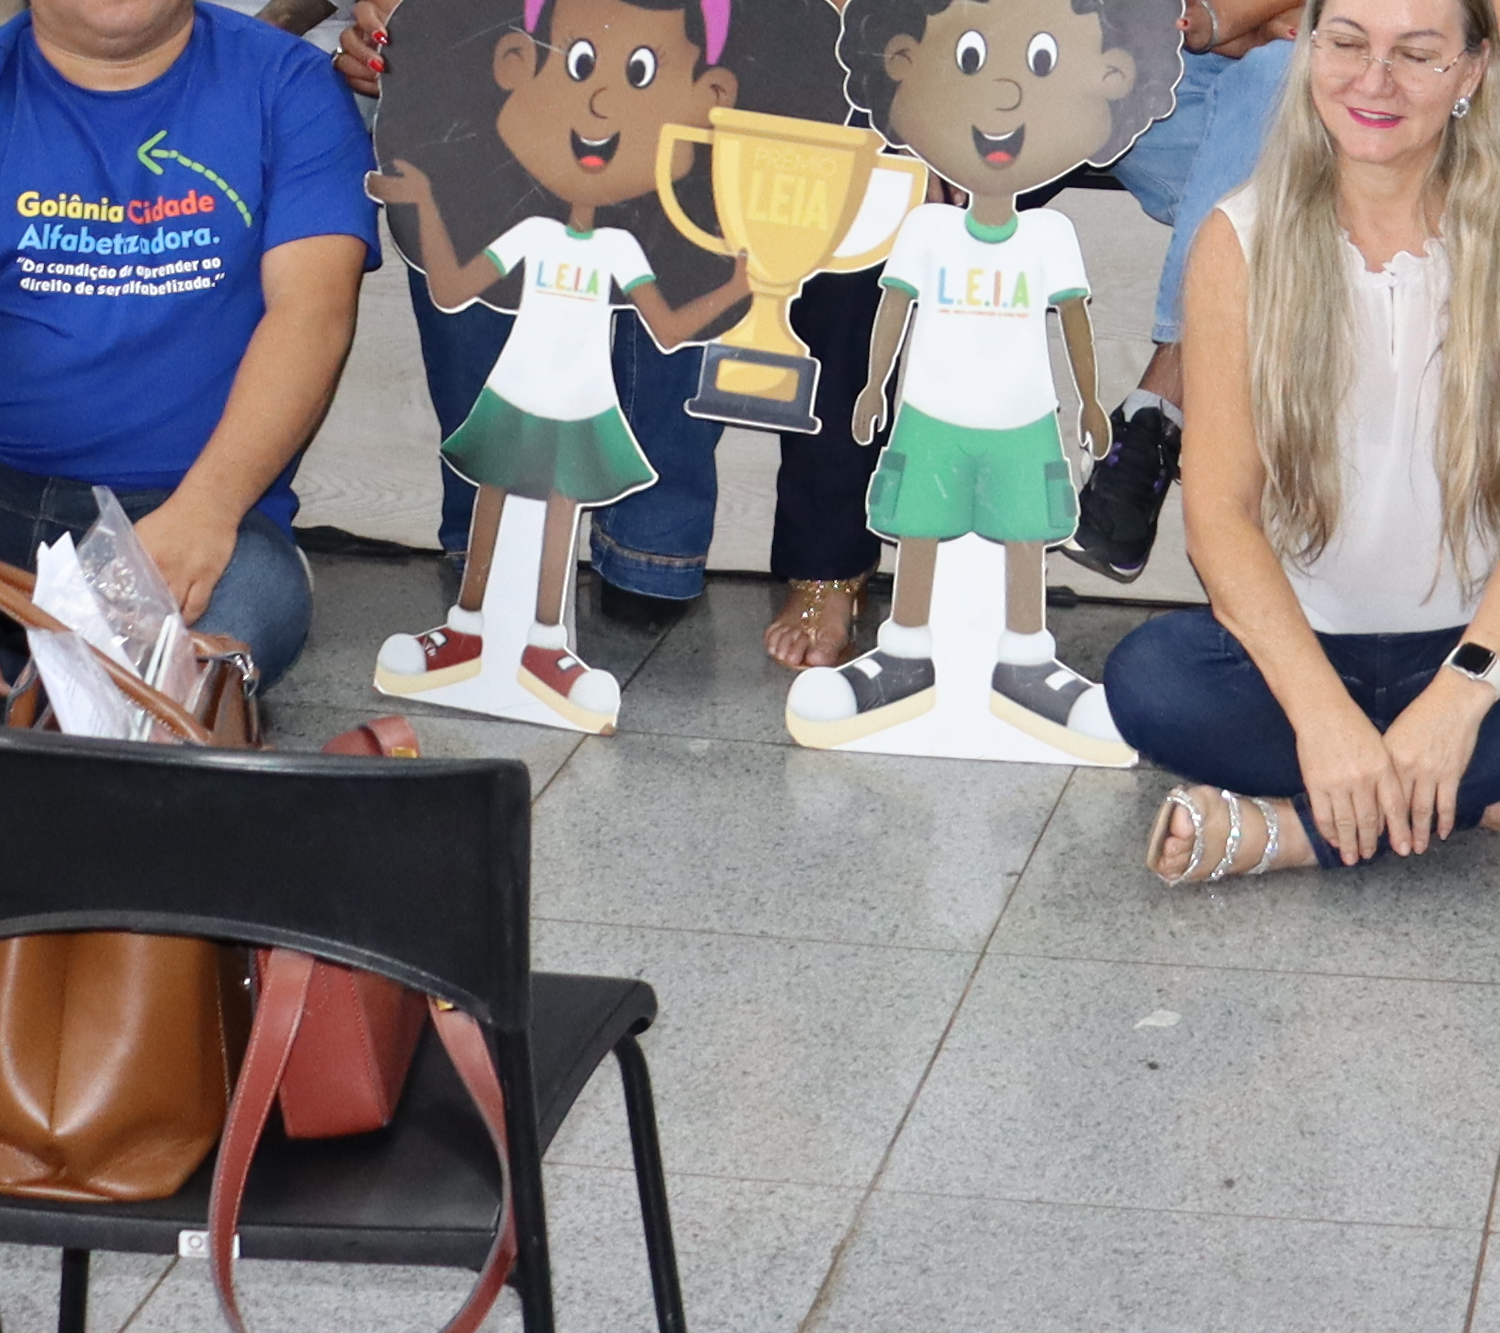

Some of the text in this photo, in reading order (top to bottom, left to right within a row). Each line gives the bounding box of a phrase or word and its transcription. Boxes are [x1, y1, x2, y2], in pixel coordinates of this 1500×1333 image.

[127, 190, 215, 224] Cidade
[746, 169, 829, 231] LEIA
[18, 222, 220, 256] Alfabetizadora.
[48, 255, 222, 280] condição aprender ao
[535, 259, 600, 295] L.E.I.A
[21, 277, 121, 296] direito de ser
[937, 266, 1031, 309] L.E.I.A
